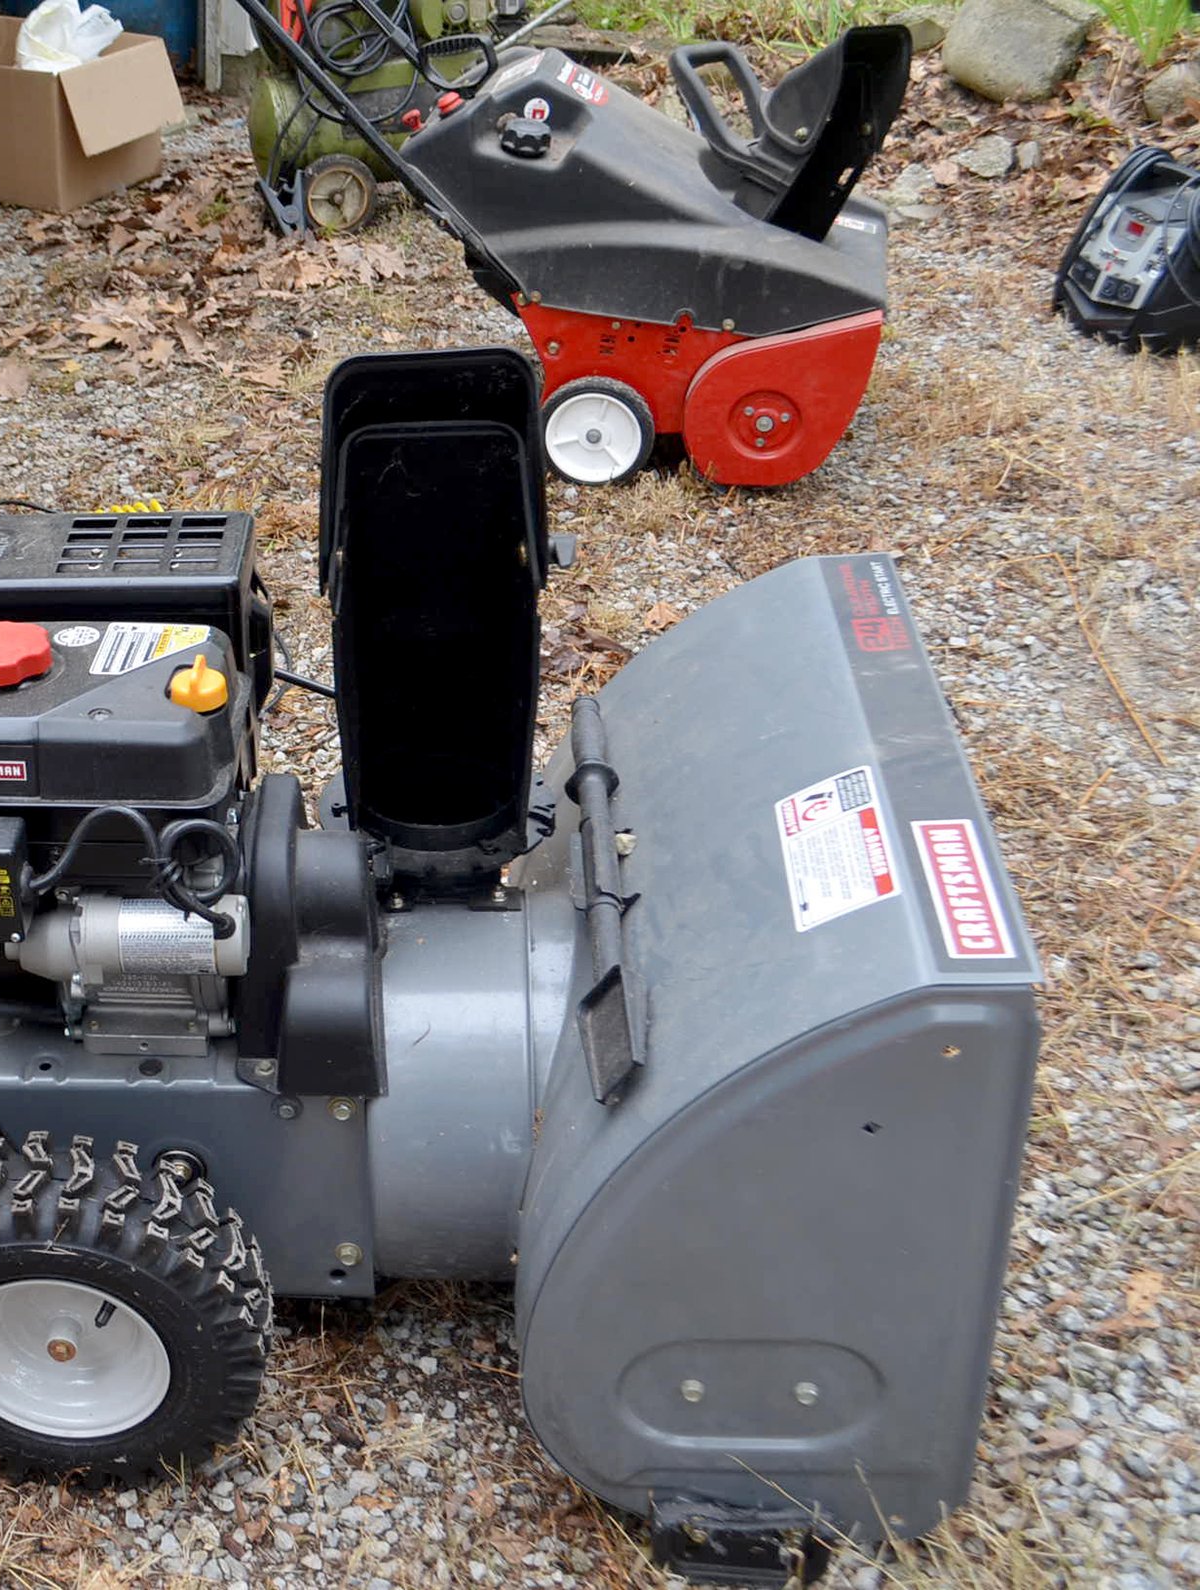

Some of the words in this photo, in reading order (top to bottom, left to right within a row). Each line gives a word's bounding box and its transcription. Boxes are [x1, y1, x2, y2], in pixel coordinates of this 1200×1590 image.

[869, 561, 889, 582] START
[877, 582, 900, 615] ELECTRIC
[928, 829, 996, 949] CRAFTSMAN
